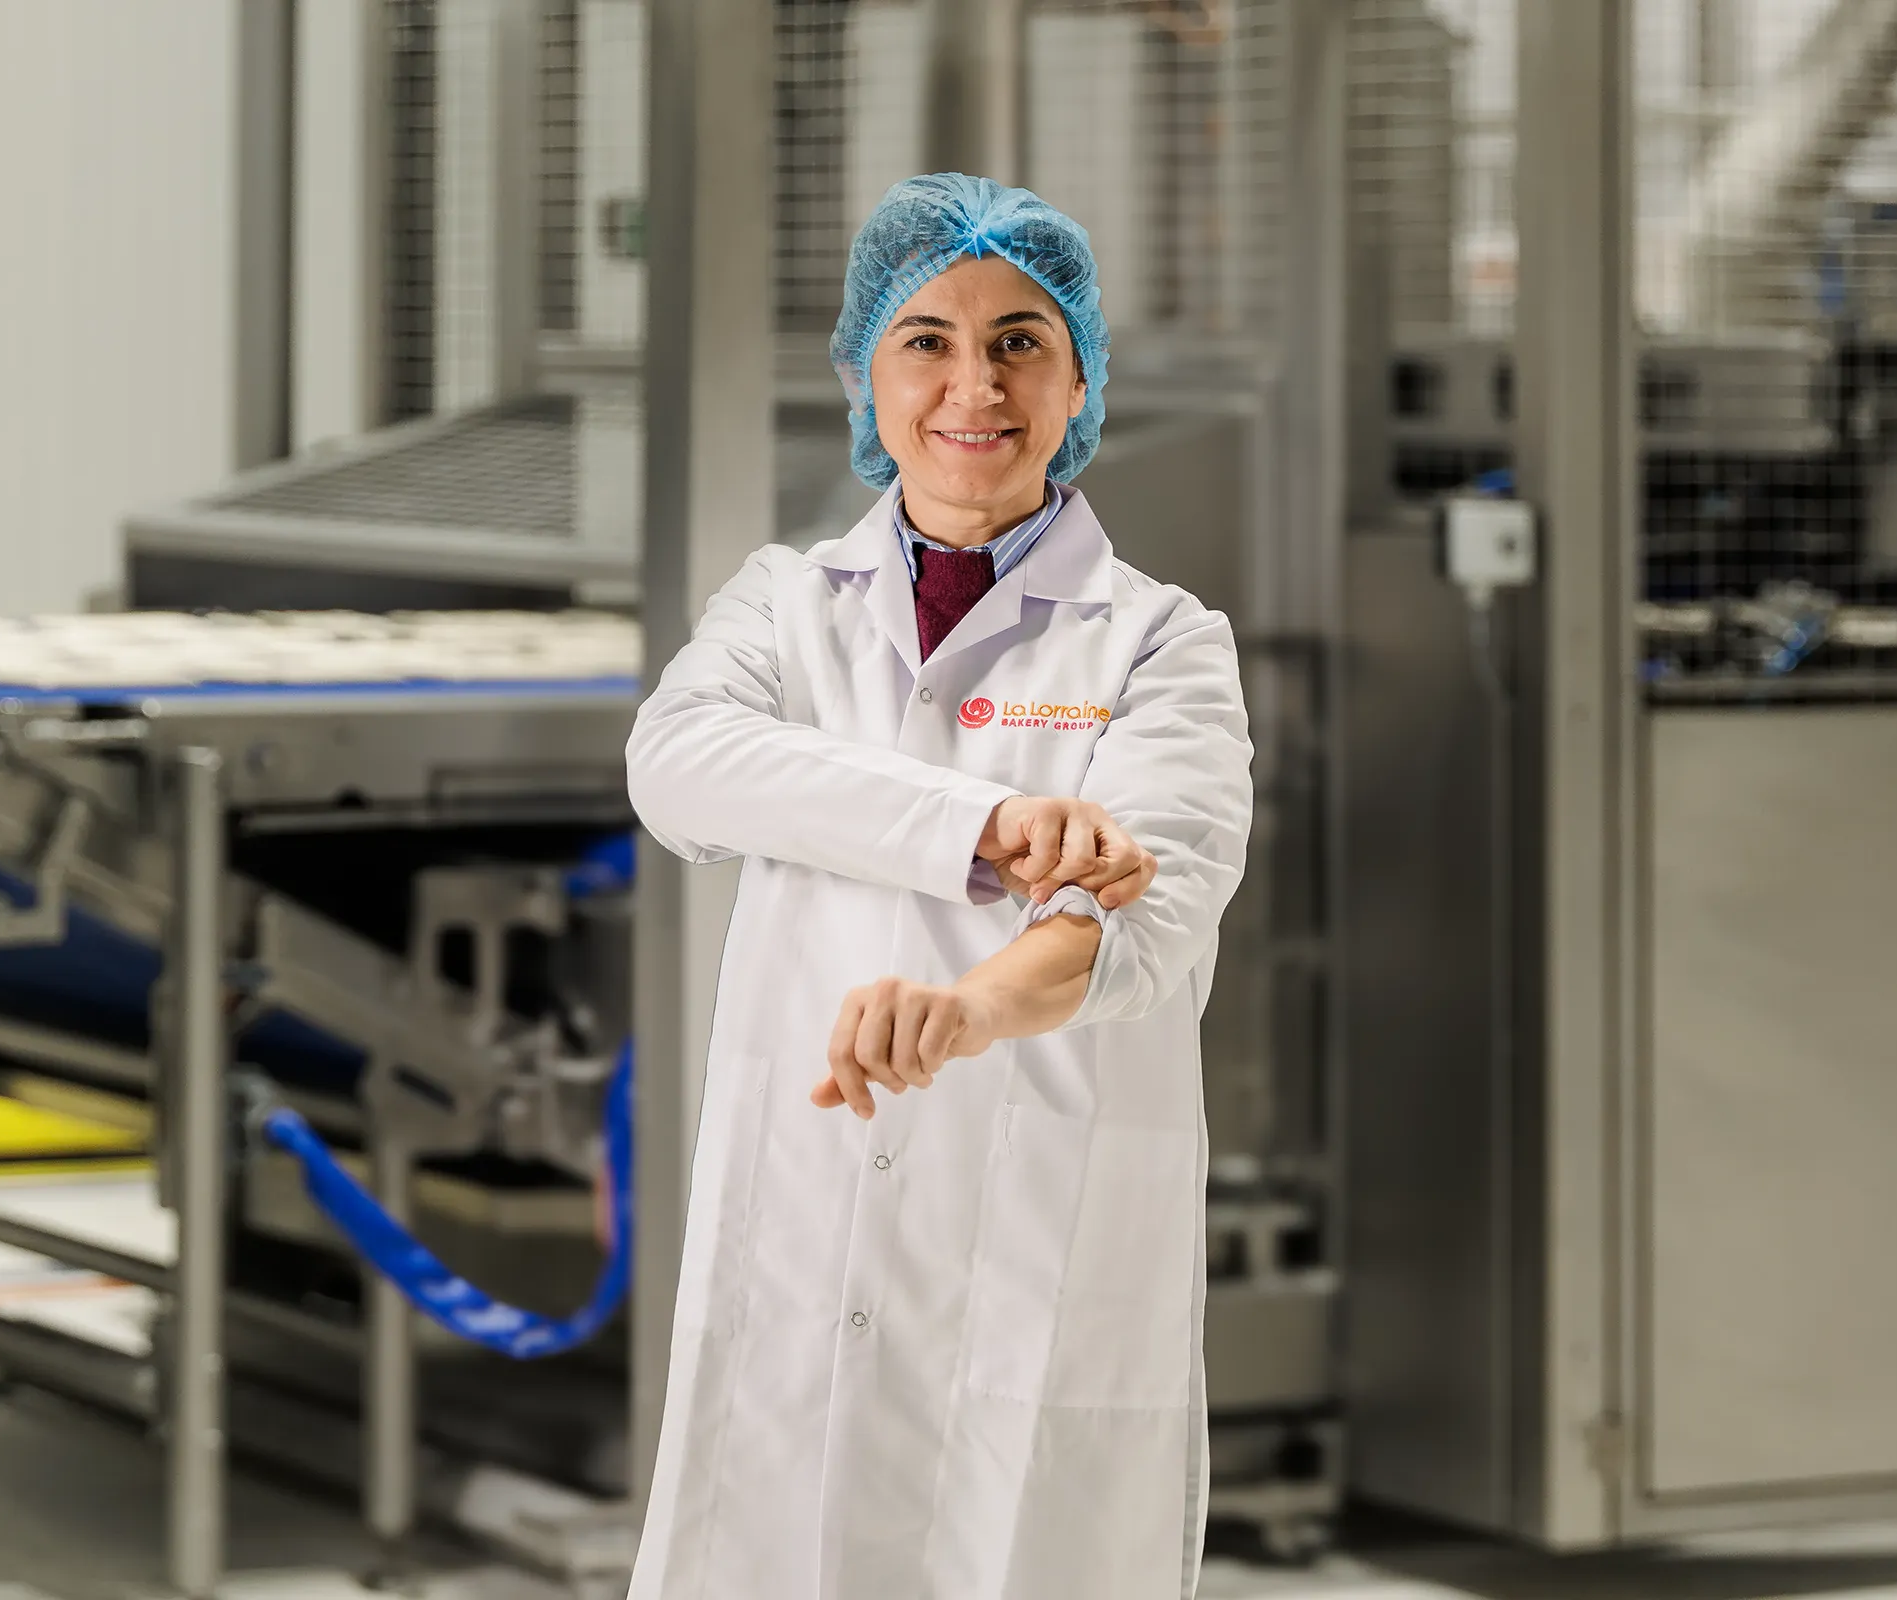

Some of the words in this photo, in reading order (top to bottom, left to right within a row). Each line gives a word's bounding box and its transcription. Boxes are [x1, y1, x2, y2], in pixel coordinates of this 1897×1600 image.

[1003, 701, 1026, 716] La
[1030, 700, 1111, 723] Lorraine
[1001, 718, 1048, 728] BAKERY
[1053, 721, 1094, 731] GROUP
